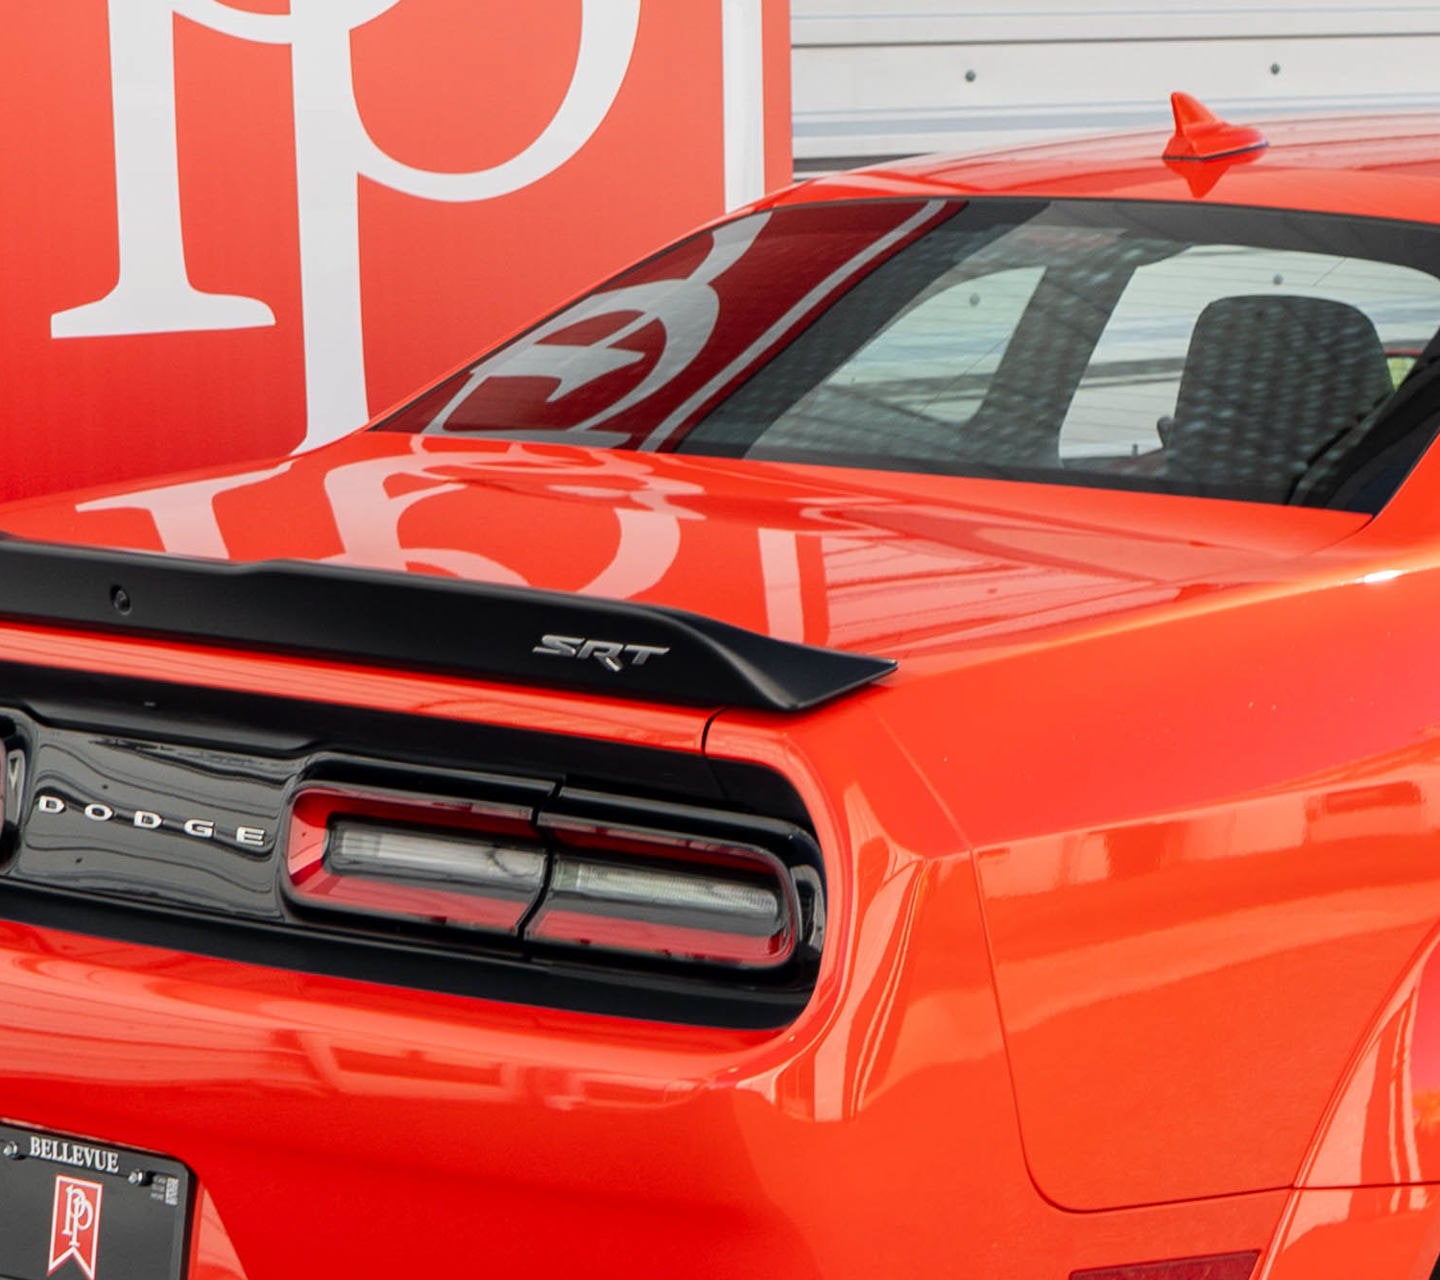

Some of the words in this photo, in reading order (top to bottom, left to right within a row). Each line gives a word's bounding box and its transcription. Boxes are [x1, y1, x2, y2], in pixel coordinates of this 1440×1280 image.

[531, 633, 671, 672] SRT
[38, 794, 266, 846] DODGE
[29, 1136, 120, 1173] BELLEVUE
